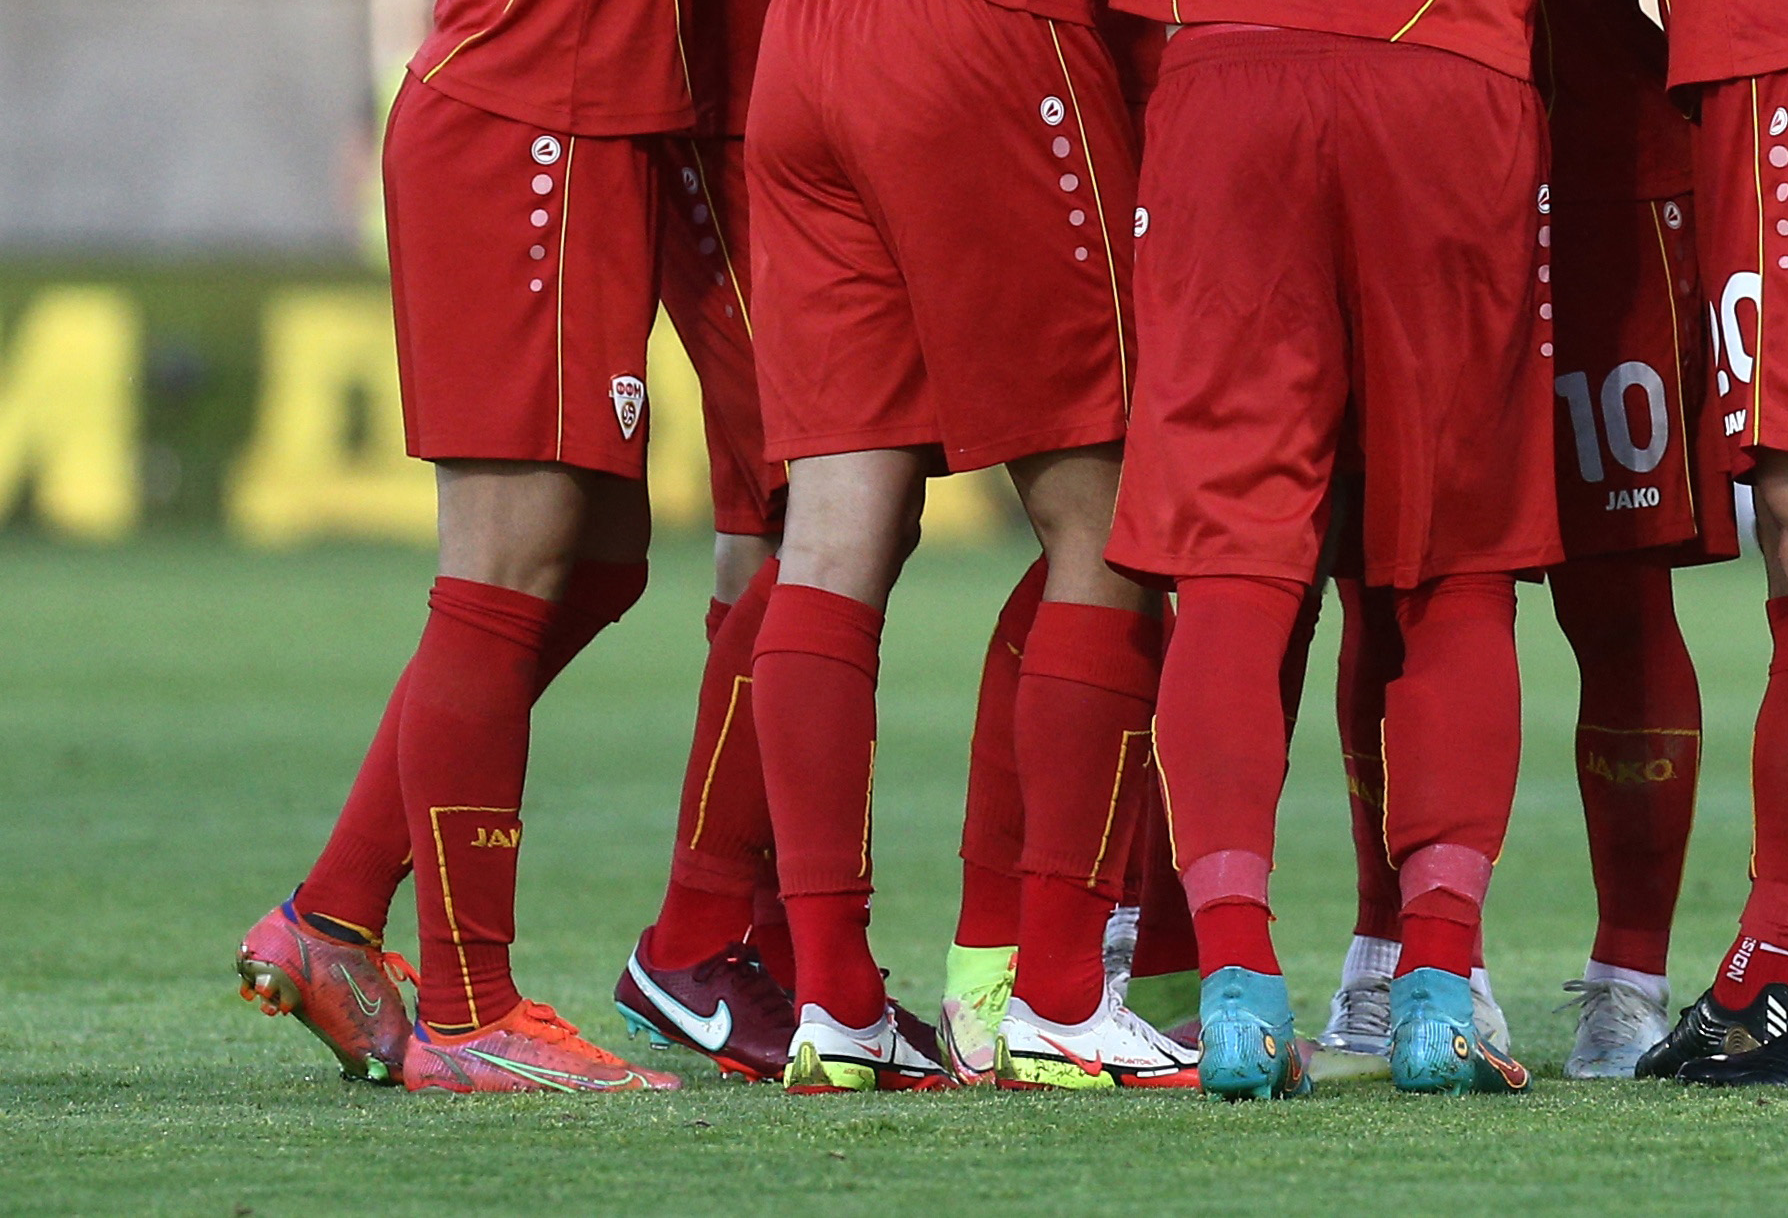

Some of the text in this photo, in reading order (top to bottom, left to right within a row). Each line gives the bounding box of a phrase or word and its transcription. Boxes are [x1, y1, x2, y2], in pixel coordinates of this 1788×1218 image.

[1708, 271, 1763, 398] 0
[1554, 360, 1669, 483] 10
[1605, 486, 1661, 511] JAKO
[1585, 750, 1676, 783] JAKO
[1726, 936, 1757, 983] SIGN
